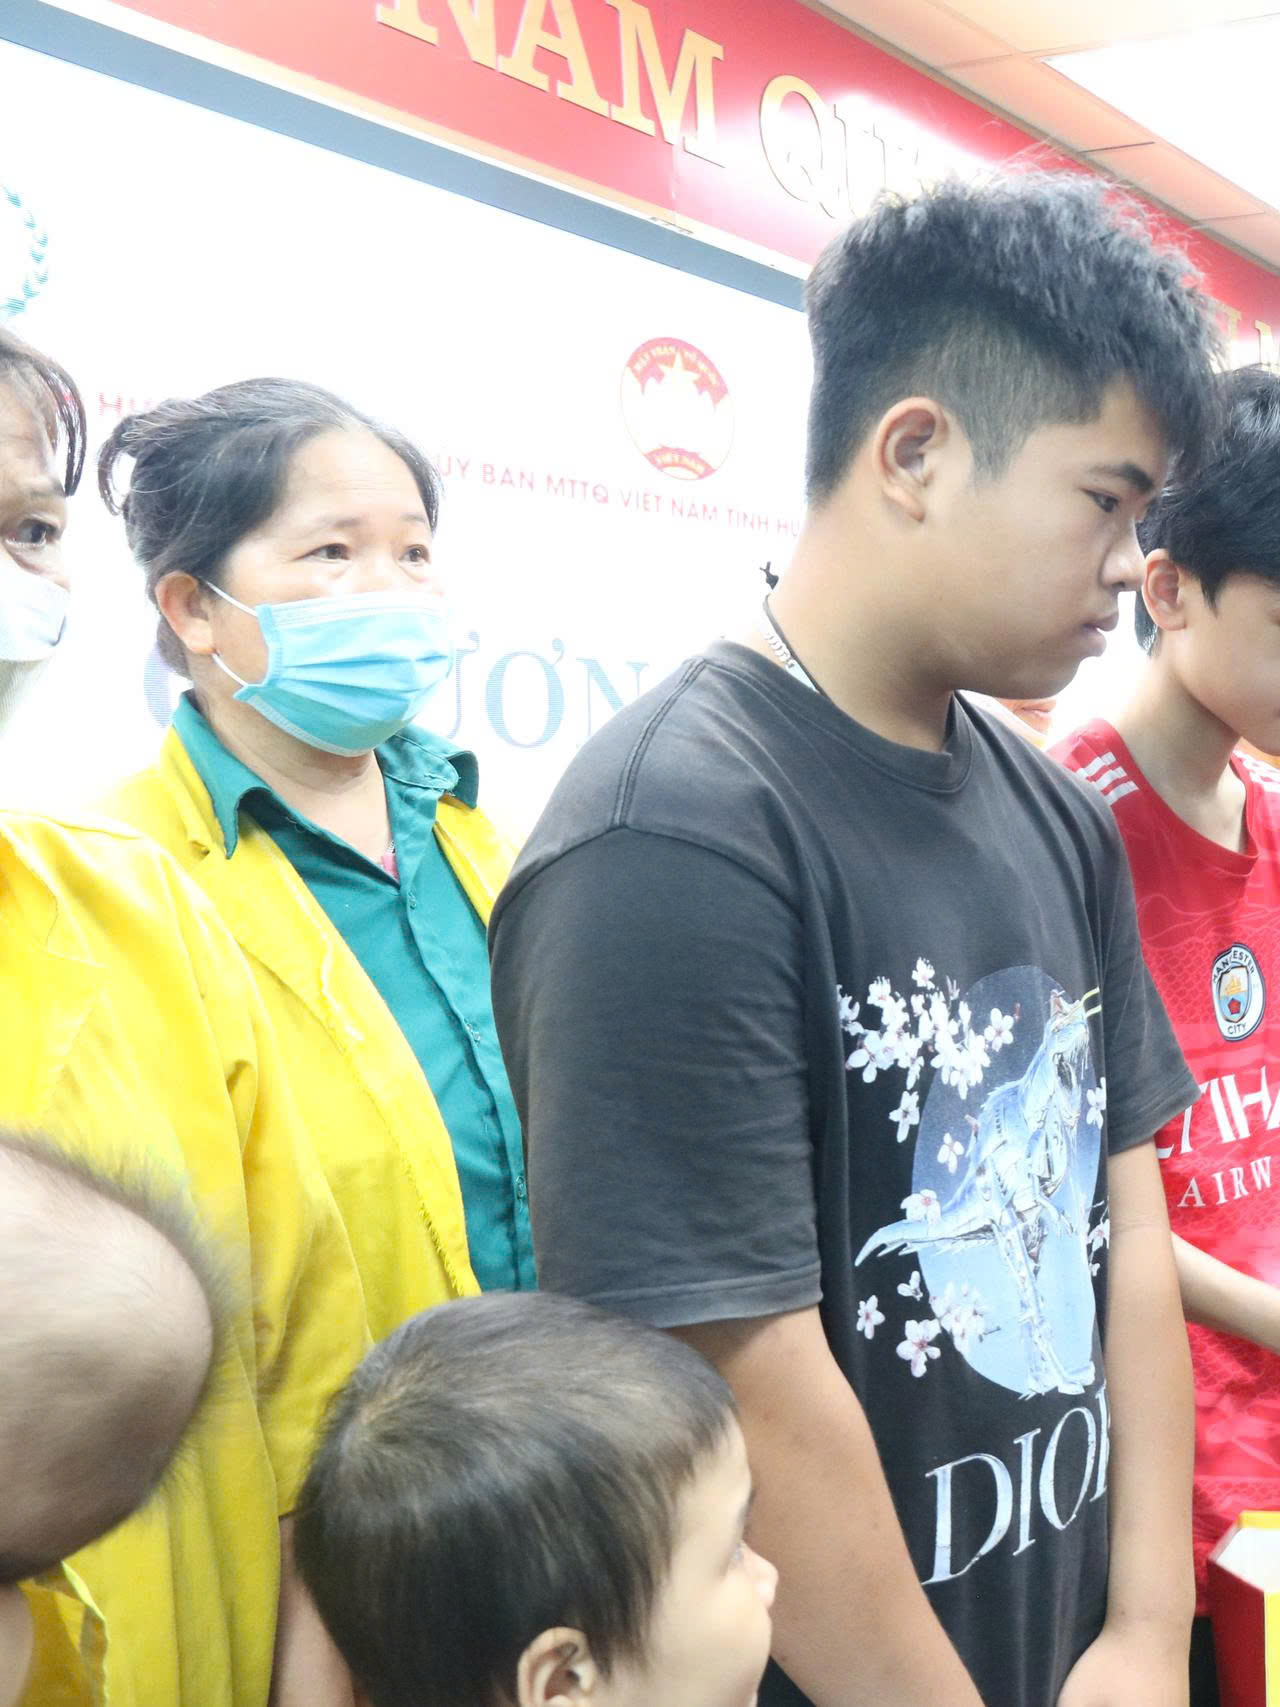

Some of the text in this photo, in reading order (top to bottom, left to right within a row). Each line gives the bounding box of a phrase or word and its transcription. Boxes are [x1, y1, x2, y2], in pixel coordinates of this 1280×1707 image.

[482, 463, 535, 492] BAN
[671, 498, 719, 521] NAM
[1227, 1022, 1248, 1035] CITY
